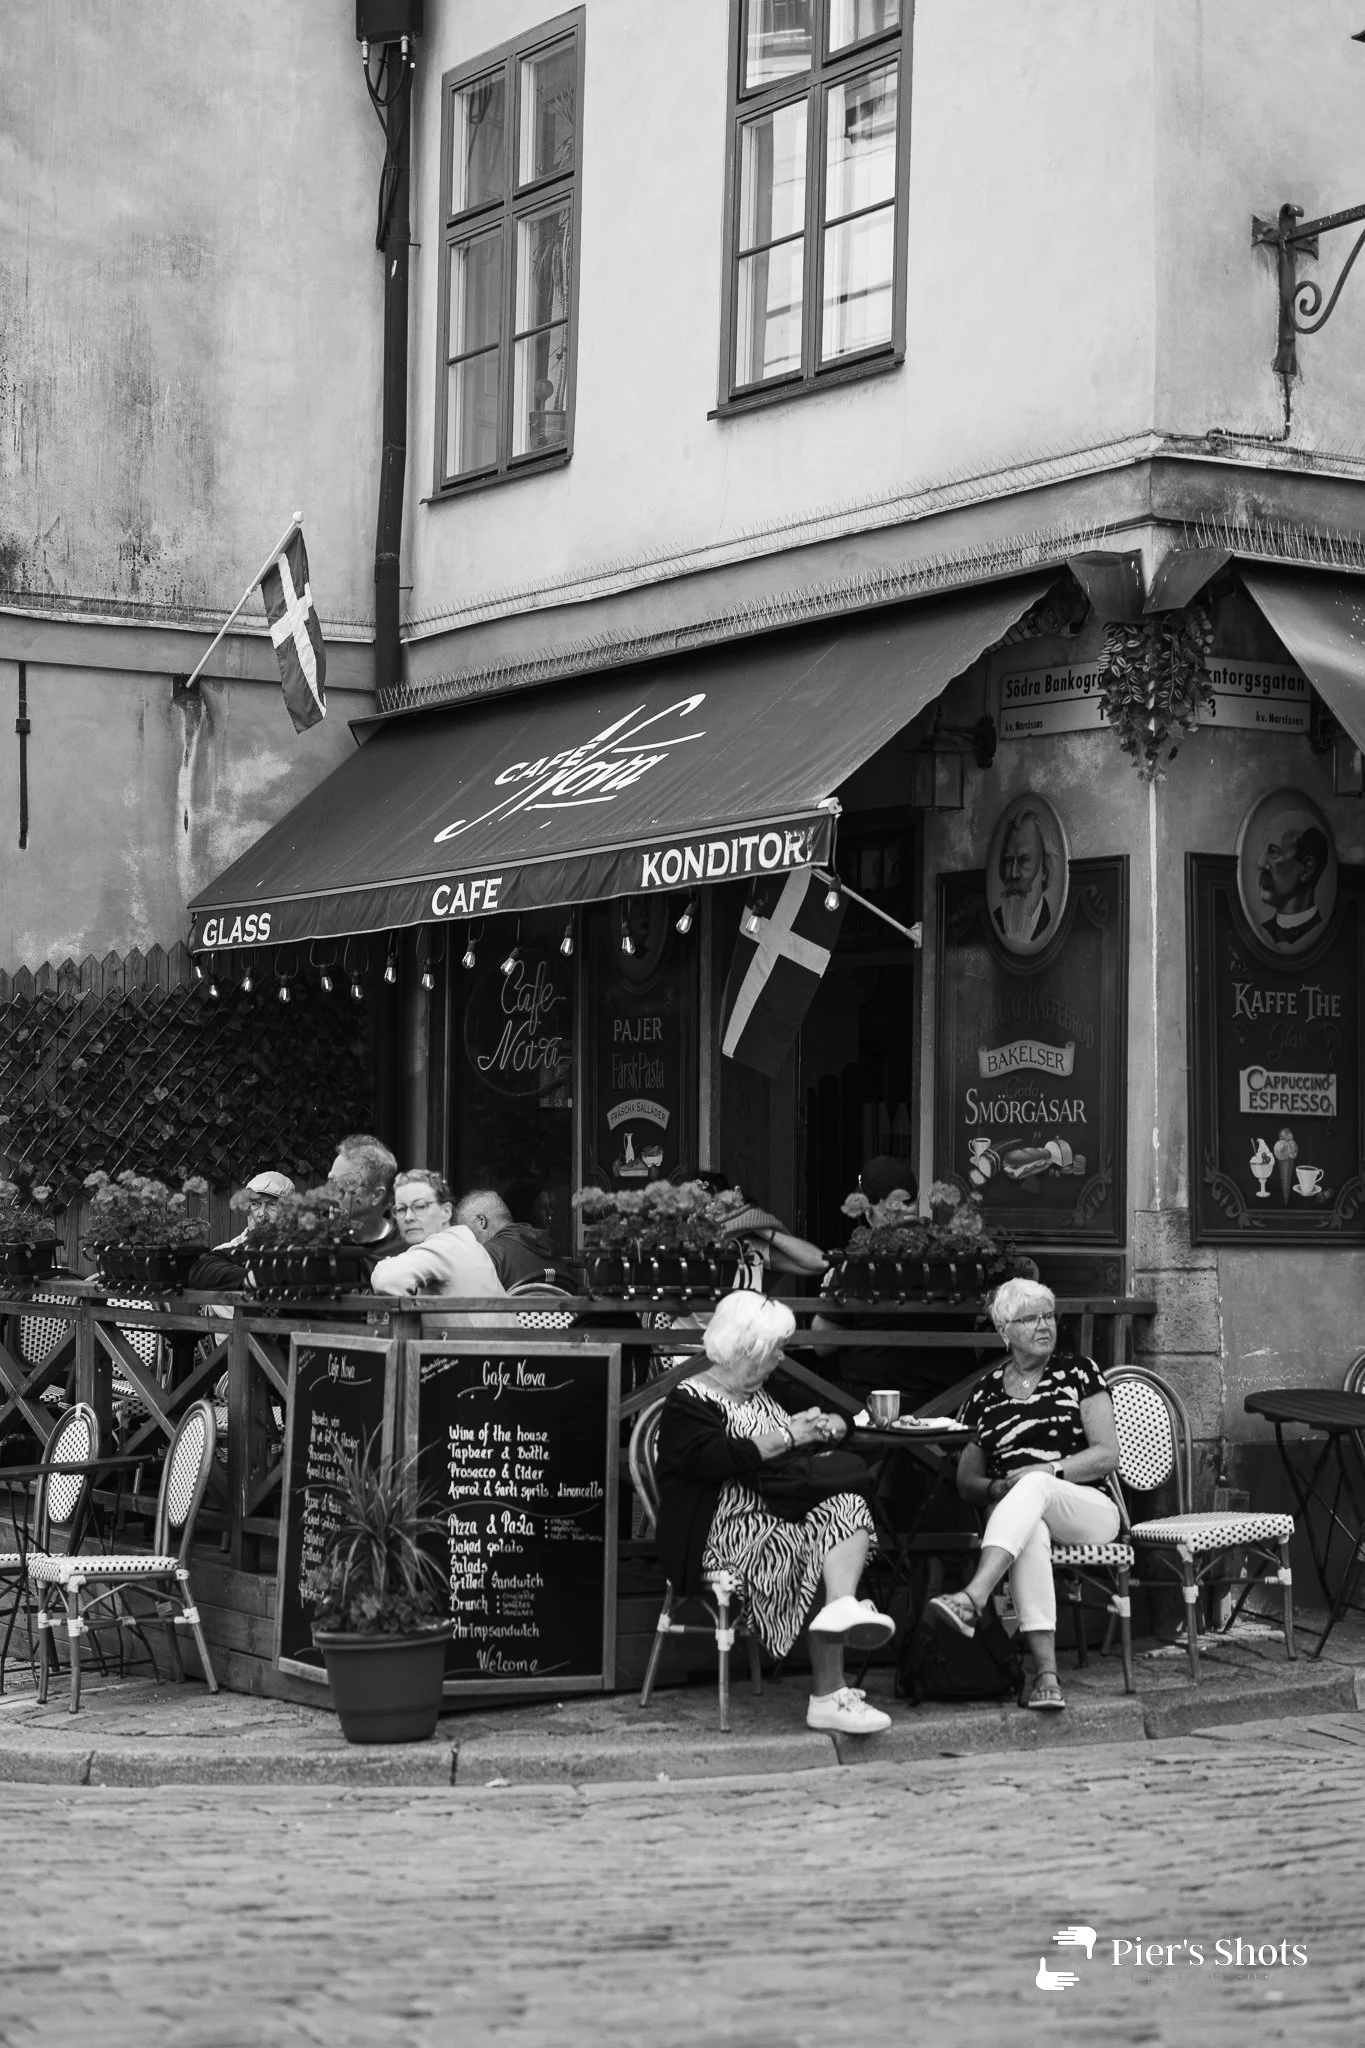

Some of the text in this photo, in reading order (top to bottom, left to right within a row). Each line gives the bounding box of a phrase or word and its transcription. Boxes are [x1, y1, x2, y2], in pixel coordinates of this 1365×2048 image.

[1006, 676, 1040, 699] Södra
[1208, 668, 1304, 695] ntorgsgatan
[1005, 719, 1043, 732] kv. Narcissus
[1256, 711, 1304, 726] kv. Narcissus
[495, 742, 601, 785] CAFE
[432, 876, 502, 917] CAFE
[203, 912, 271, 947] GLASS
[501, 960, 566, 1035] Cafe
[1232, 981, 1341, 1023] KAFFE THE
[613, 1017, 663, 1042] PAJER
[478, 1020, 572, 1071] Nova
[638, 1052, 664, 1089] Pasta
[987, 1045, 1065, 1073] BAKELSER
[1247, 1069, 1330, 1092] CAPPUCCINO
[636, 1101, 666, 1123] SALLADER
[965, 1087, 1088, 1125] SMÖRGÅSAR
[1249, 1092, 1331, 1113] ESPRESSO
[482, 1360, 511, 1401] Cafe
[516, 1360, 546, 1387] Nova
[449, 1422, 549, 1446] Wine of the house
[517, 1445, 550, 1461] Bottle
[448, 1462, 545, 1480] Prosecco & Cider
[448, 1480, 480, 1500] Aperol
[448, 1513, 478, 1536] Pizza
[501, 1510, 536, 1536] Pasta
[448, 1537, 524, 1557] Baked potato
[450, 1554, 488, 1574] Salads
[450, 1571, 545, 1593] Grilled Sandwich
[449, 1592, 489, 1615] Brunch
[477, 1644, 538, 1673] Welcome
